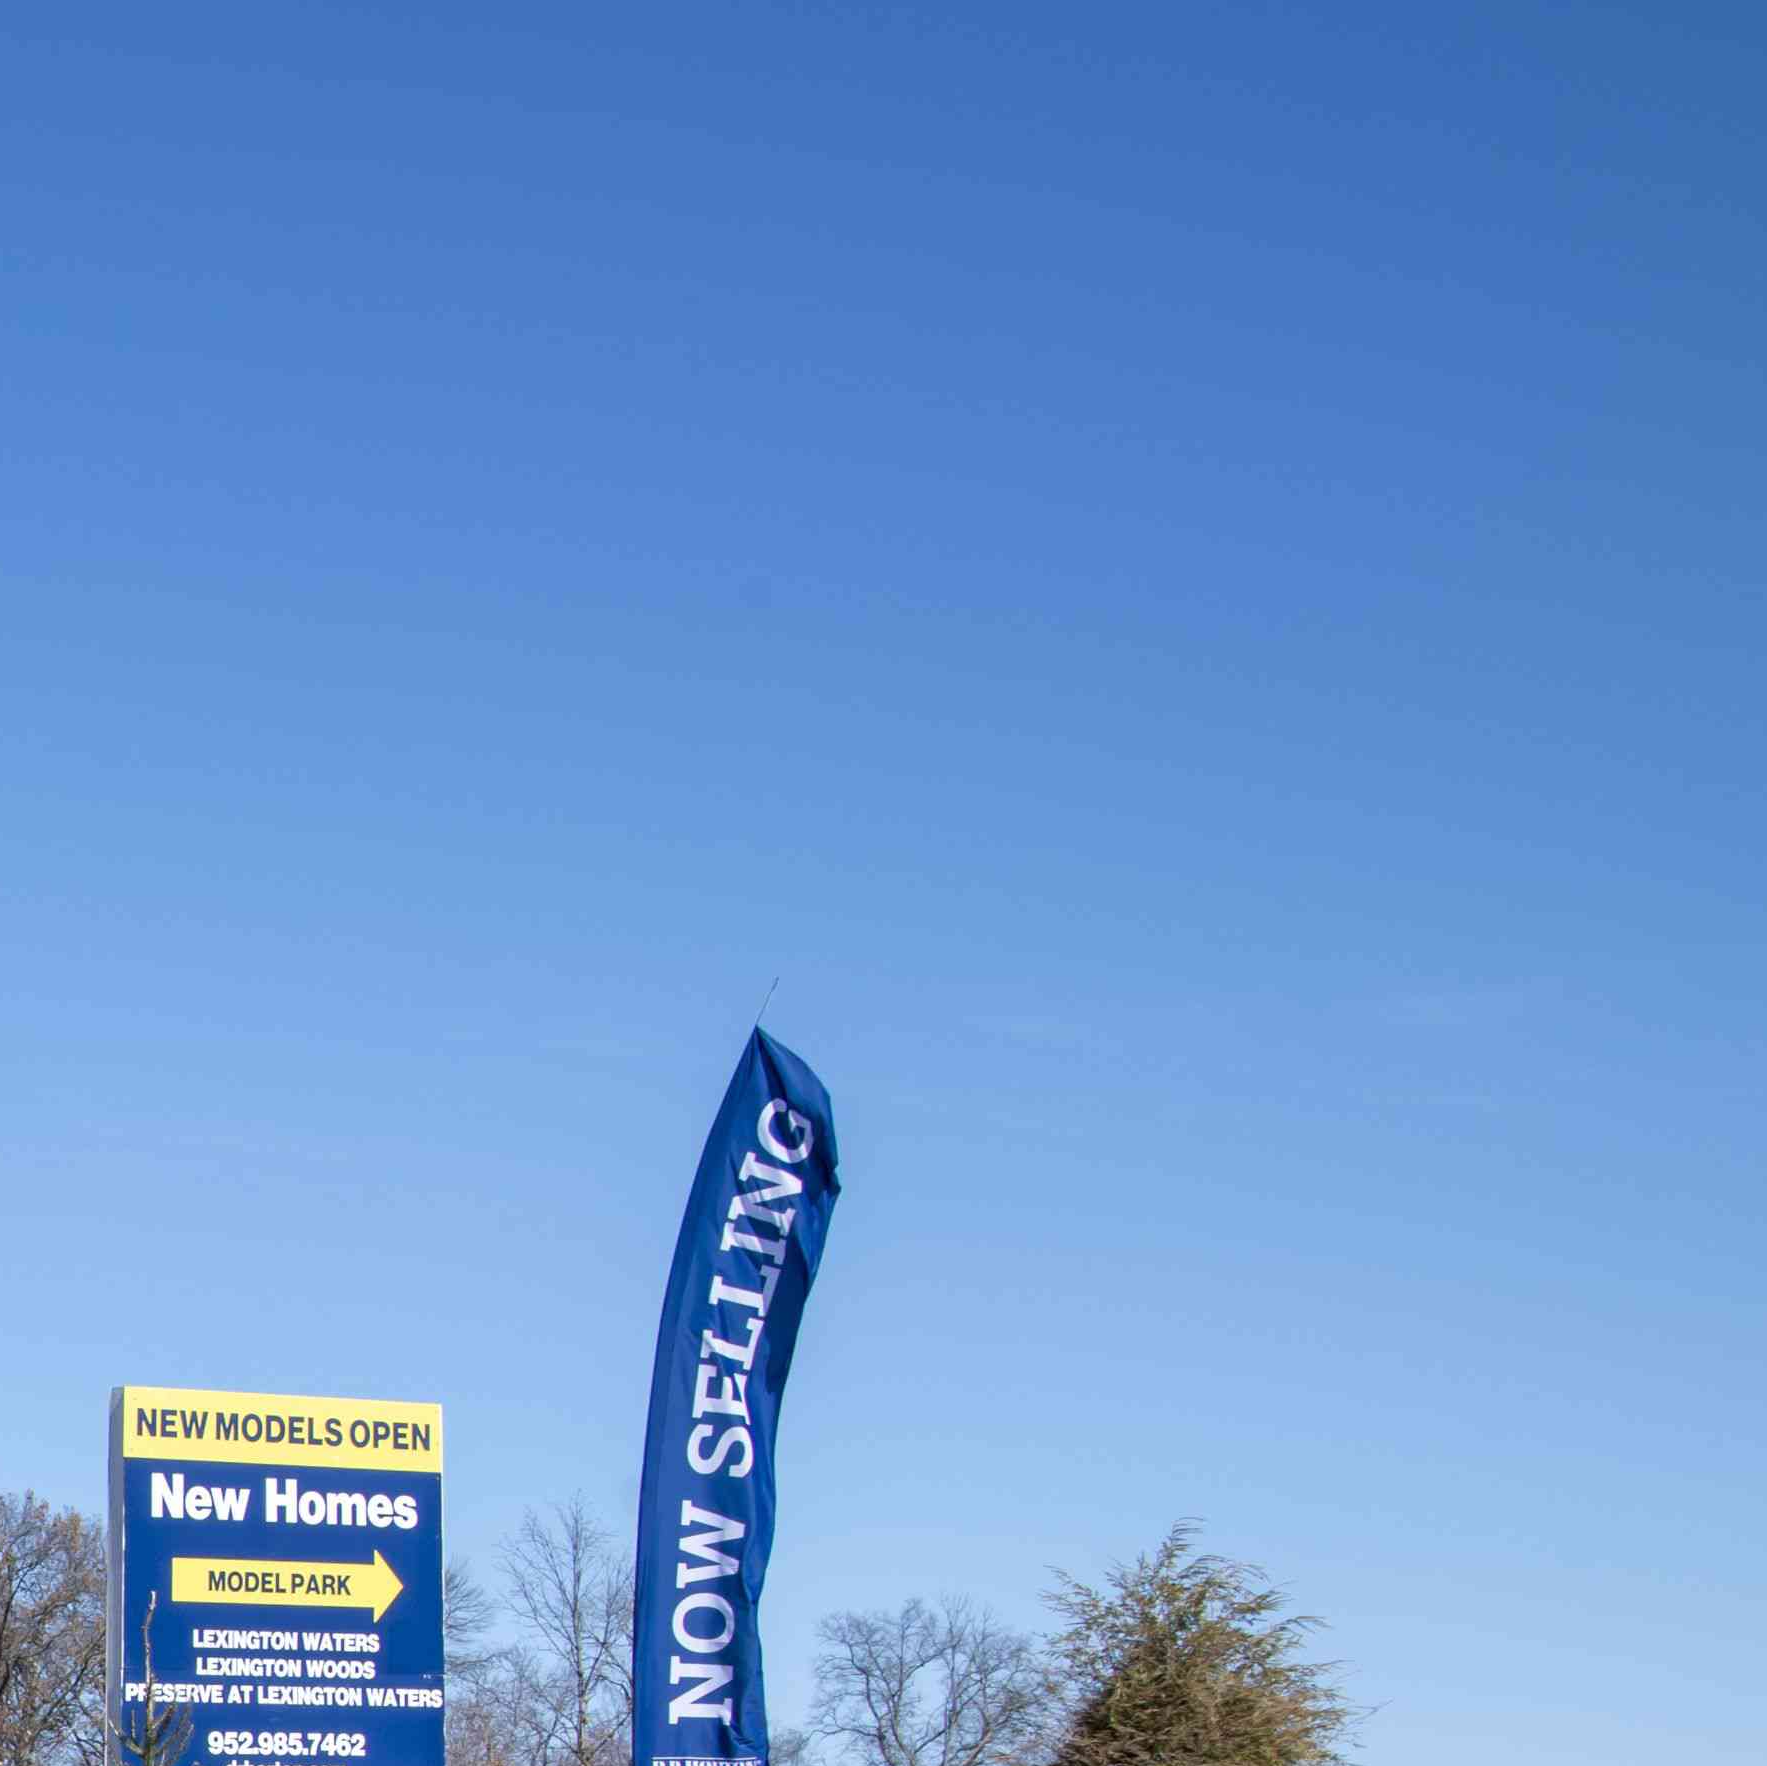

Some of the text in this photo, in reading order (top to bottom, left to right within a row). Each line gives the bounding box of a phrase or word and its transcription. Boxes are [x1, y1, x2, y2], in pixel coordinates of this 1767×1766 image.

[667, 1098, 815, 1727] NOW SELLING
[136, 1408, 431, 1451] NEW MODELS OPEN
[151, 1472, 418, 1529] New Homes
[208, 1571, 351, 1596] MODEL PARK
[193, 1629, 380, 1653] LEXINGTON WATERS
[196, 1657, 375, 1679] LEXINGTON WOODS
[125, 1682, 443, 1708] PRESERVE AT LEXINGTON WATERS
[207, 1731, 366, 1757] 952.985.7462
